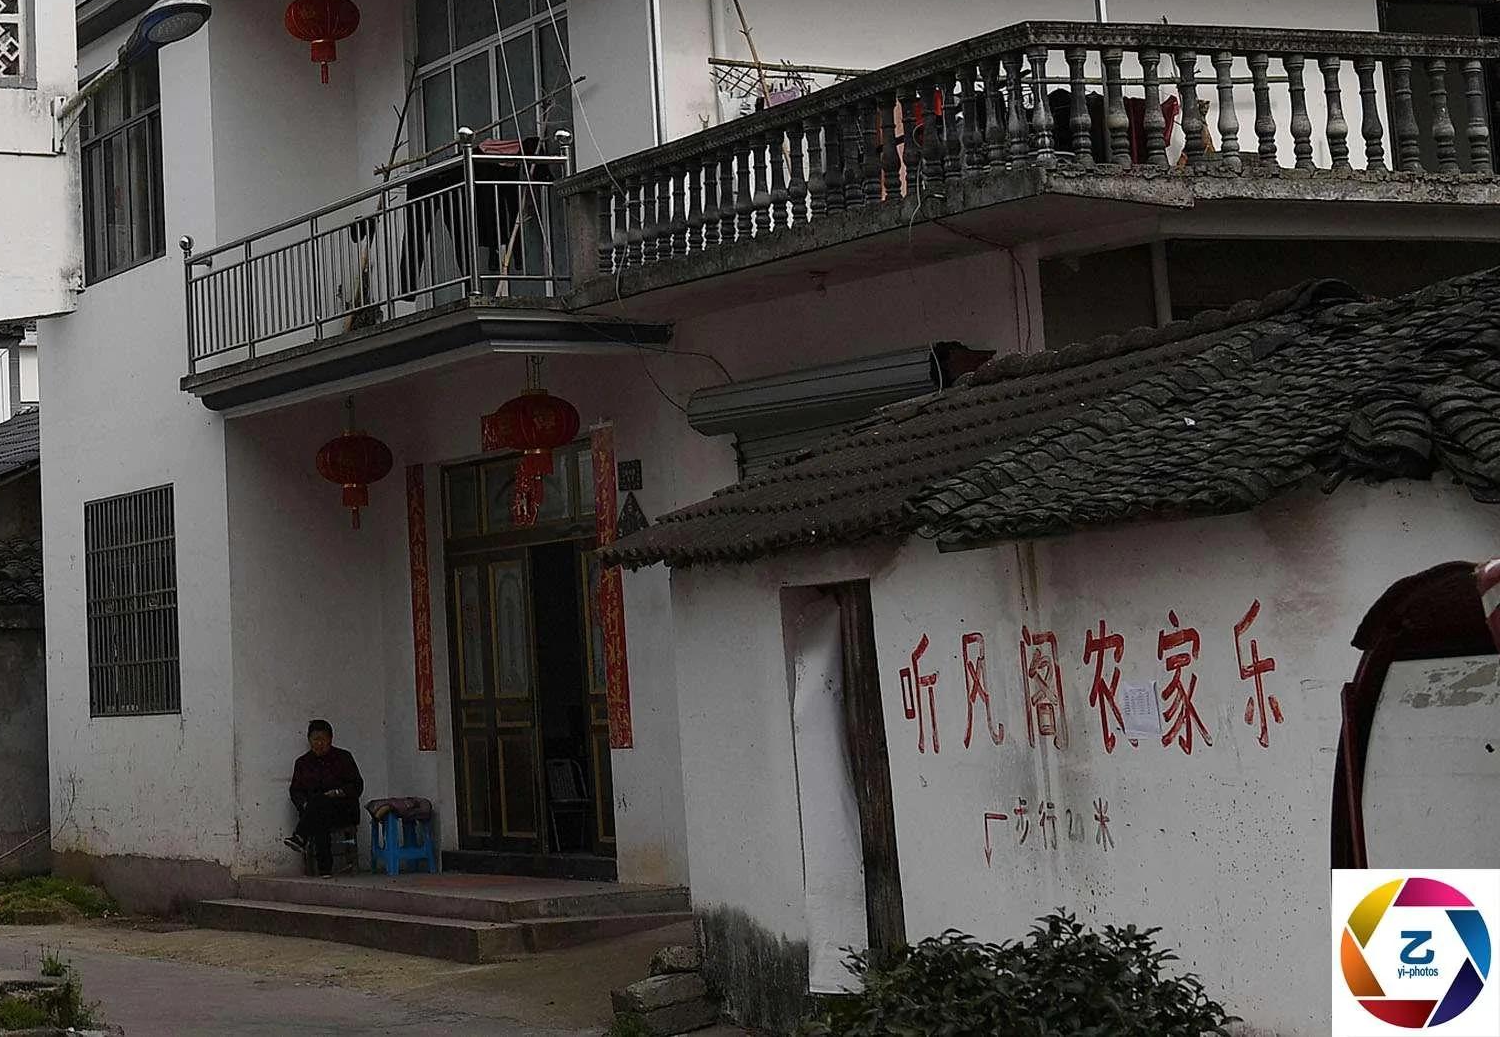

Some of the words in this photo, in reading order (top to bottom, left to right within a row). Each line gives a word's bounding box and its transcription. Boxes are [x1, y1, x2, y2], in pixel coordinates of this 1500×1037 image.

[899, 599, 1284, 755] 听风阁农家乐
